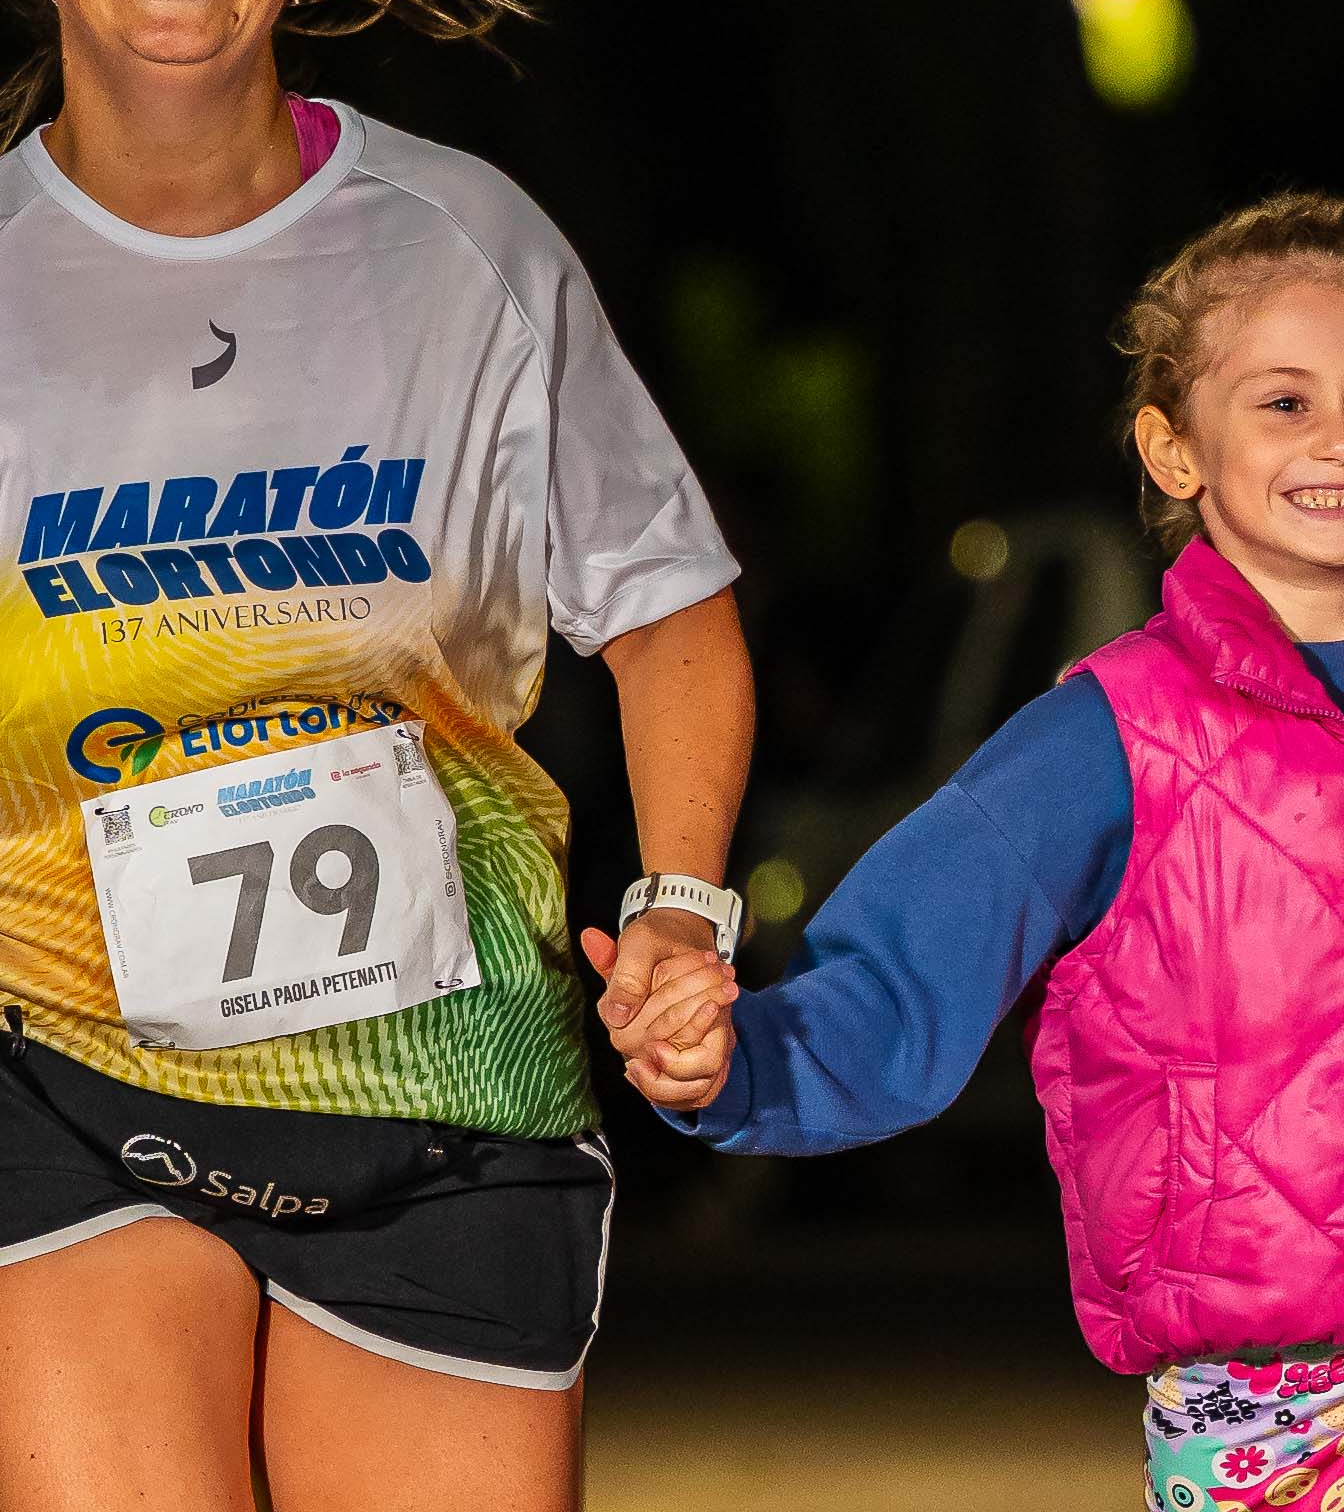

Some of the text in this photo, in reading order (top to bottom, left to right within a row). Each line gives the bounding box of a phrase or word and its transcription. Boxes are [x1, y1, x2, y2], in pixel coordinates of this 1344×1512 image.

[17, 444, 426, 565] MARATÓN
[22, 527, 432, 619] ELORTONDO
[102, 596, 371, 645] 137 ANIVERSARIO
[217, 768, 312, 805] MARATÓN
[218, 786, 316, 818] ELORTONDO
[187, 824, 380, 984] 79
[220, 961, 398, 1018] GISELA PAOLA PETENATTI
[200, 1170, 329, 1218] Salpa
